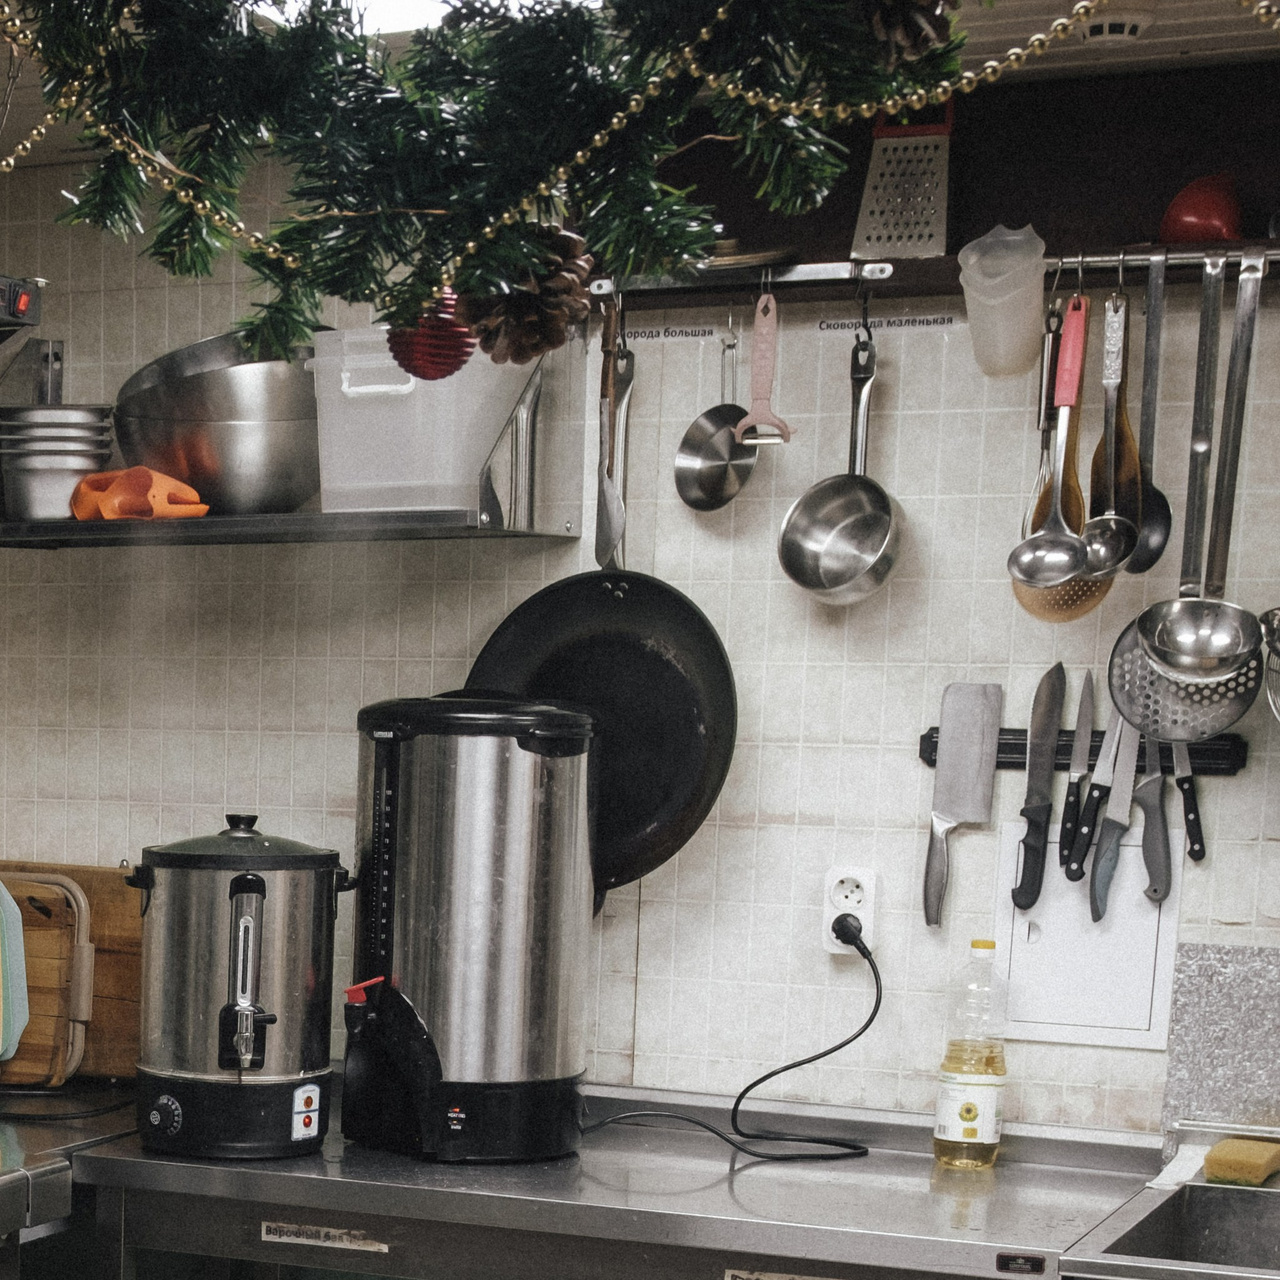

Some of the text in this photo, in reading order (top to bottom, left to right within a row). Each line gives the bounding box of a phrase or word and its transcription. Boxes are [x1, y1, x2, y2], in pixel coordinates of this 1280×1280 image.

[819, 315, 953, 331] Сковорда маленькая
[663, 327, 714, 338] большая
